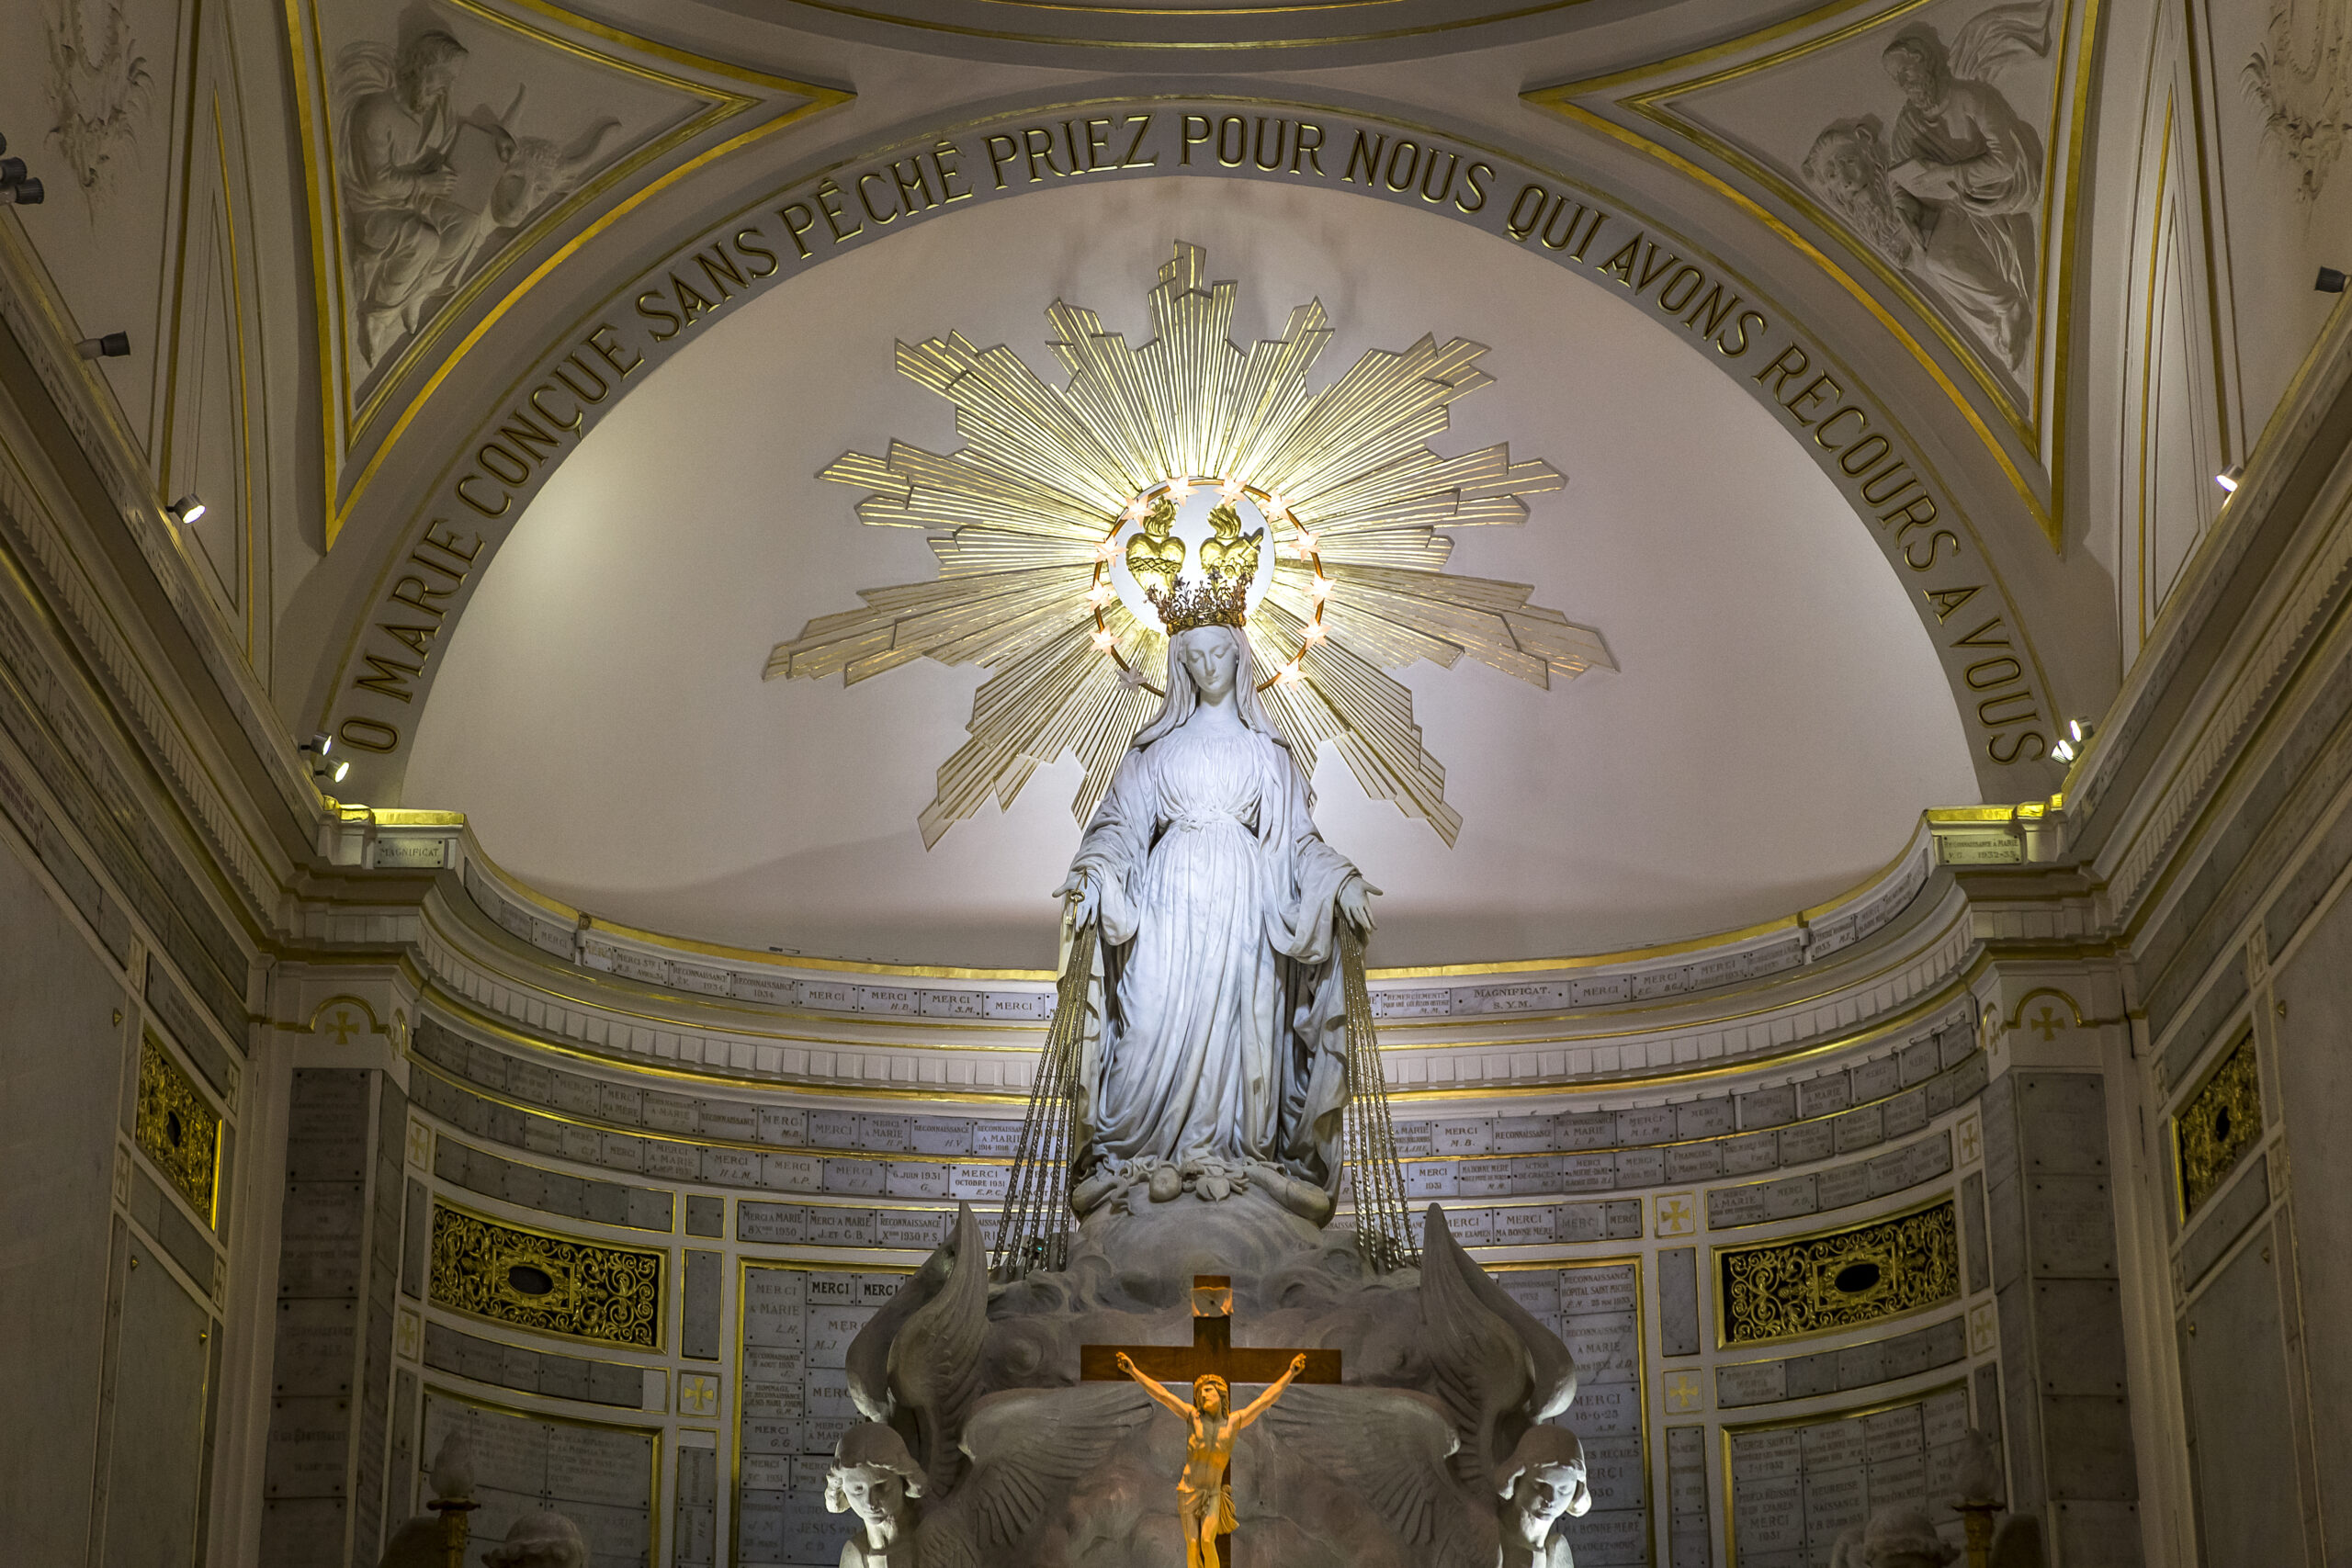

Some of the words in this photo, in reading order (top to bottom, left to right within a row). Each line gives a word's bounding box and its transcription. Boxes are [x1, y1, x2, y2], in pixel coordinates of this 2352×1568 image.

[1177, 113, 1327, 177] POUR
[985, 113, 1158, 191] PRIEZ
[1341, 128, 1497, 214] NOUS
[1507, 184, 1609, 265] QUI
[635, 229, 779, 343] SANS
[1597, 231, 1769, 358] AVONS
[455, 323, 644, 519] CONÇUE
[1752, 341, 1961, 572] RECOURS
[353, 518, 486, 704] MARIE
[1923, 584, 1988, 626] A
[1950, 616, 2046, 766] VOUS
[338, 717, 400, 754] O
[380, 848, 439, 859] MAGNIFICAT
[808, 990, 845, 1001] MERCI
[872, 991, 908, 1001] MERCI
[1583, 986, 1619, 997] MERCI
[932, 994, 970, 1004] MERCI
[995, 1001, 1033, 1011] MERCI
[607, 1089, 635, 1101] MERCI
[1815, 1088, 1843, 1100] MARIE
[763, 1115, 803, 1126] MERCI
[872, 1119, 899, 1128] MERCI
[816, 1123, 853, 1135] MERCI
[872, 1129, 903, 1138] MARIE
[914, 1124, 969, 1134] RECONNAISSANCE
[1444, 1127, 1477, 1135] MERCI
[1495, 1129, 1553, 1140] RECONNAISSANCE
[1574, 1126, 1604, 1135] MARIE
[610, 1145, 636, 1158] MERCI
[657, 1145, 688, 1156] MERCI
[661, 1155, 695, 1168] MARIE
[714, 1154, 748, 1166] MERCI
[775, 1161, 810, 1171] MERCI
[836, 1167, 873, 1176] MERCI
[961, 1169, 998, 1179] MERCI
[1419, 1168, 1448, 1177] MERCI
[1721, 1196, 1757, 1207] MARIE
[743, 1211, 768, 1222] MERCI
[775, 1213, 802, 1224] MARIE
[809, 1215, 834, 1225] MERCI
[845, 1216, 871, 1227] MARIE
[880, 1218, 942, 1227] RECONNAISSANCE
[1507, 1214, 1542, 1224] MERCI
[1562, 1218, 1599, 1228] MERCI
[1610, 1213, 1638, 1224] MERCI
[900, 1231, 920, 1241] 1930
[1508, 1227, 1532, 1236] BONNE
[1565, 1272, 1630, 1284] RECONNAISSANCE
[756, 1284, 797, 1296] MERCI
[812, 1281, 850, 1295] MERCI
[864, 1284, 899, 1296] MERCI
[760, 1303, 800, 1316] MARIE
[1586, 1341, 1621, 1353] MARIE
[754, 1426, 789, 1435] MERCI
[815, 1422, 843, 1430] MERCI
[1736, 1439, 1765, 1451] VIERGE
[1767, 1435, 1796, 1448] SAINTE
[1588, 1467, 1623, 1479] ERCI
[1812, 1480, 1858, 1496] HEUREUSE
[1813, 1497, 1860, 1514] NAISSANCE
[1749, 1517, 1790, 1529] MERCI
